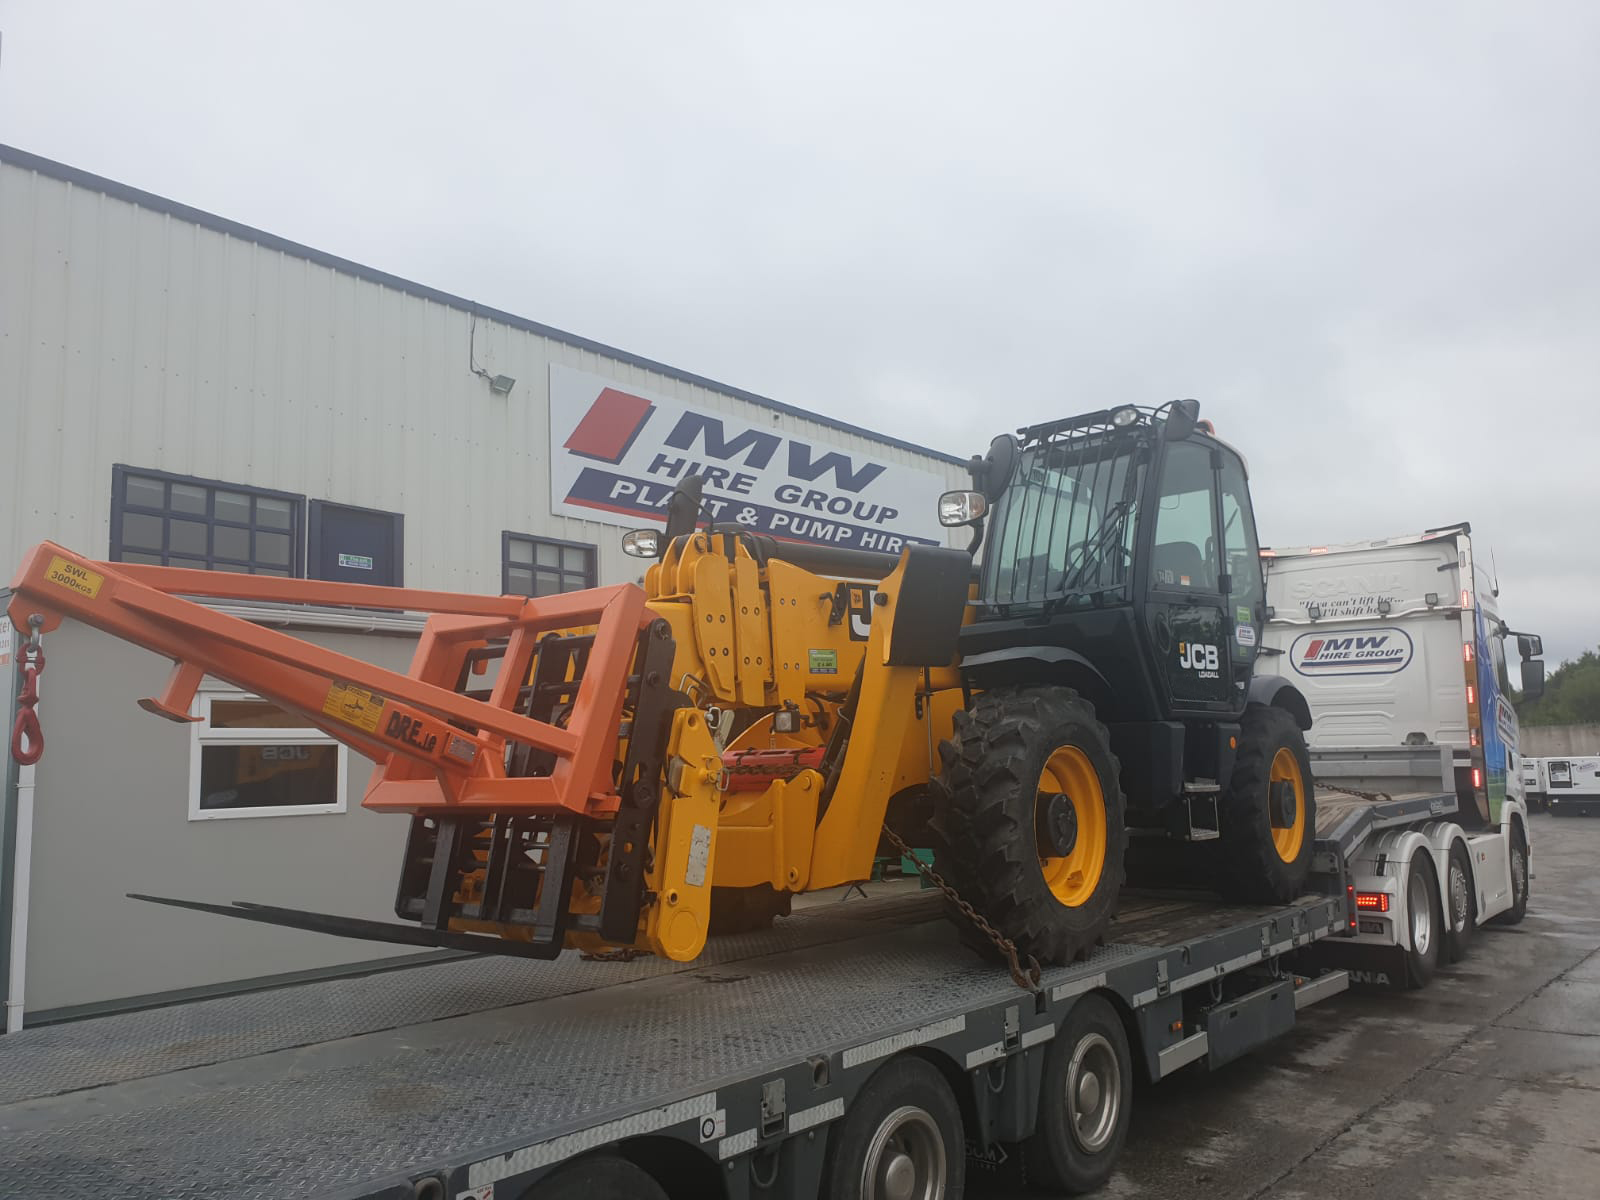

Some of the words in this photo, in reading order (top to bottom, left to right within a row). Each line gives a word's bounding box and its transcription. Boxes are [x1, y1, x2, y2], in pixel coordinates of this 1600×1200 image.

[663, 410, 887, 493] MW
[647, 453, 757, 495] HIRE
[774, 484, 899, 524] GROUP
[735, 507, 759, 526] &
[769, 513, 853, 542] PUMP
[859, 532, 920, 553] HIR
[64, 564, 88, 581] SWL
[1330, 598, 1356, 607] can't
[1359, 597, 1375, 605] lift
[1340, 606, 1363, 616] shift
[1323, 636, 1389, 651] MW
[1180, 643, 1219, 670] JCB
[1319, 652, 1352, 660] HIRE
[1355, 648, 1404, 658] GROUP
